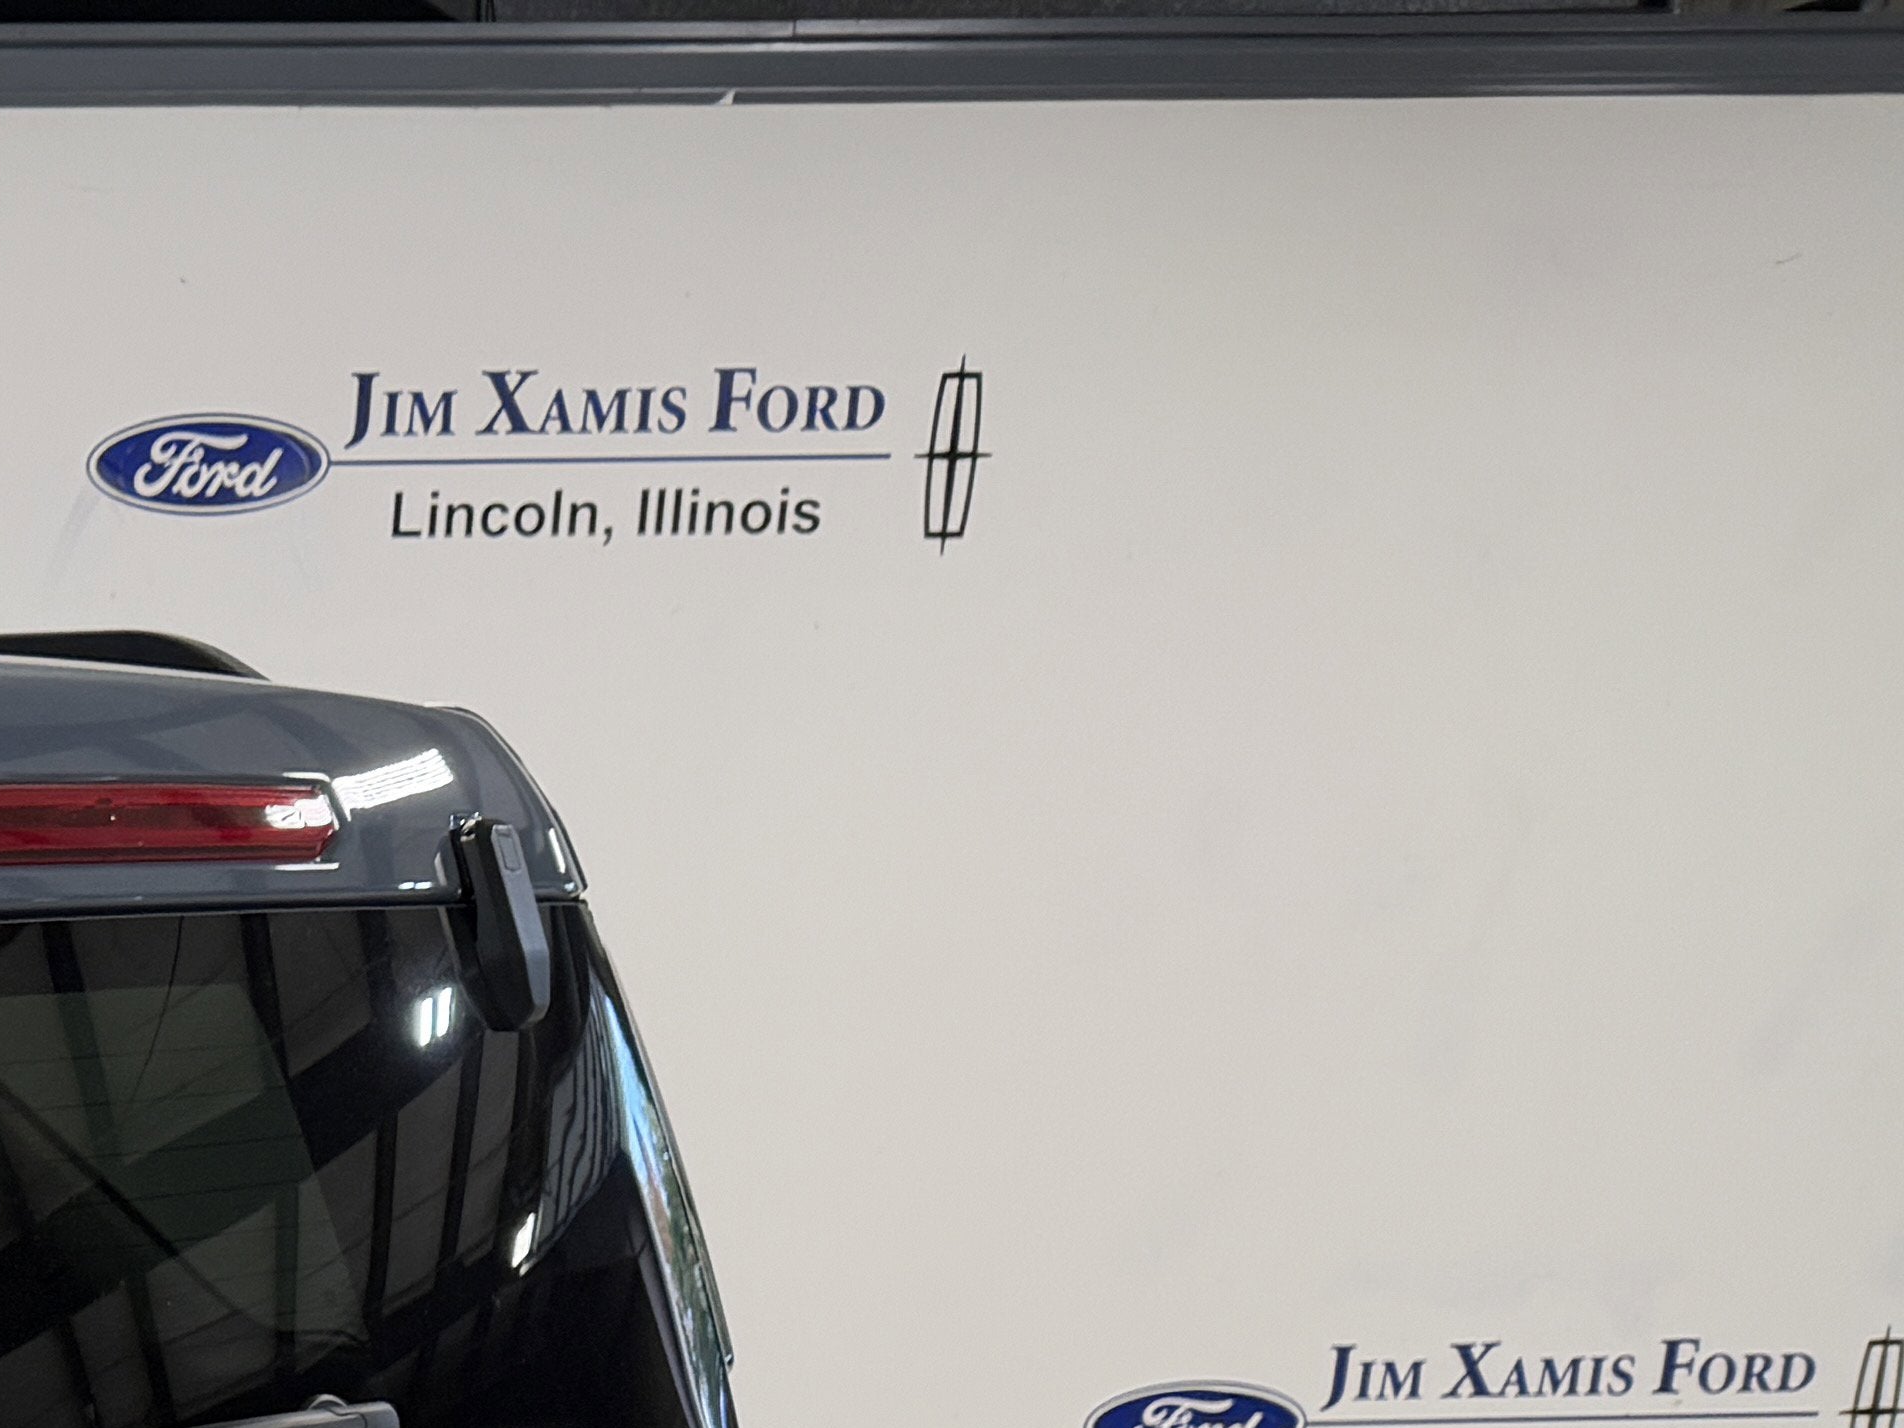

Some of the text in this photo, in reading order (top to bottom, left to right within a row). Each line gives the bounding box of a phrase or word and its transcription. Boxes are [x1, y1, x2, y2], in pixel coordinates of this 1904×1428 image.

[343, 367, 887, 451] JIM XAMIS FORD
[133, 431, 279, 498] Ford
[390, 486, 822, 548] Lincoln, Illinois
[1319, 1337, 1818, 1413] JIM XAMIS FORD
